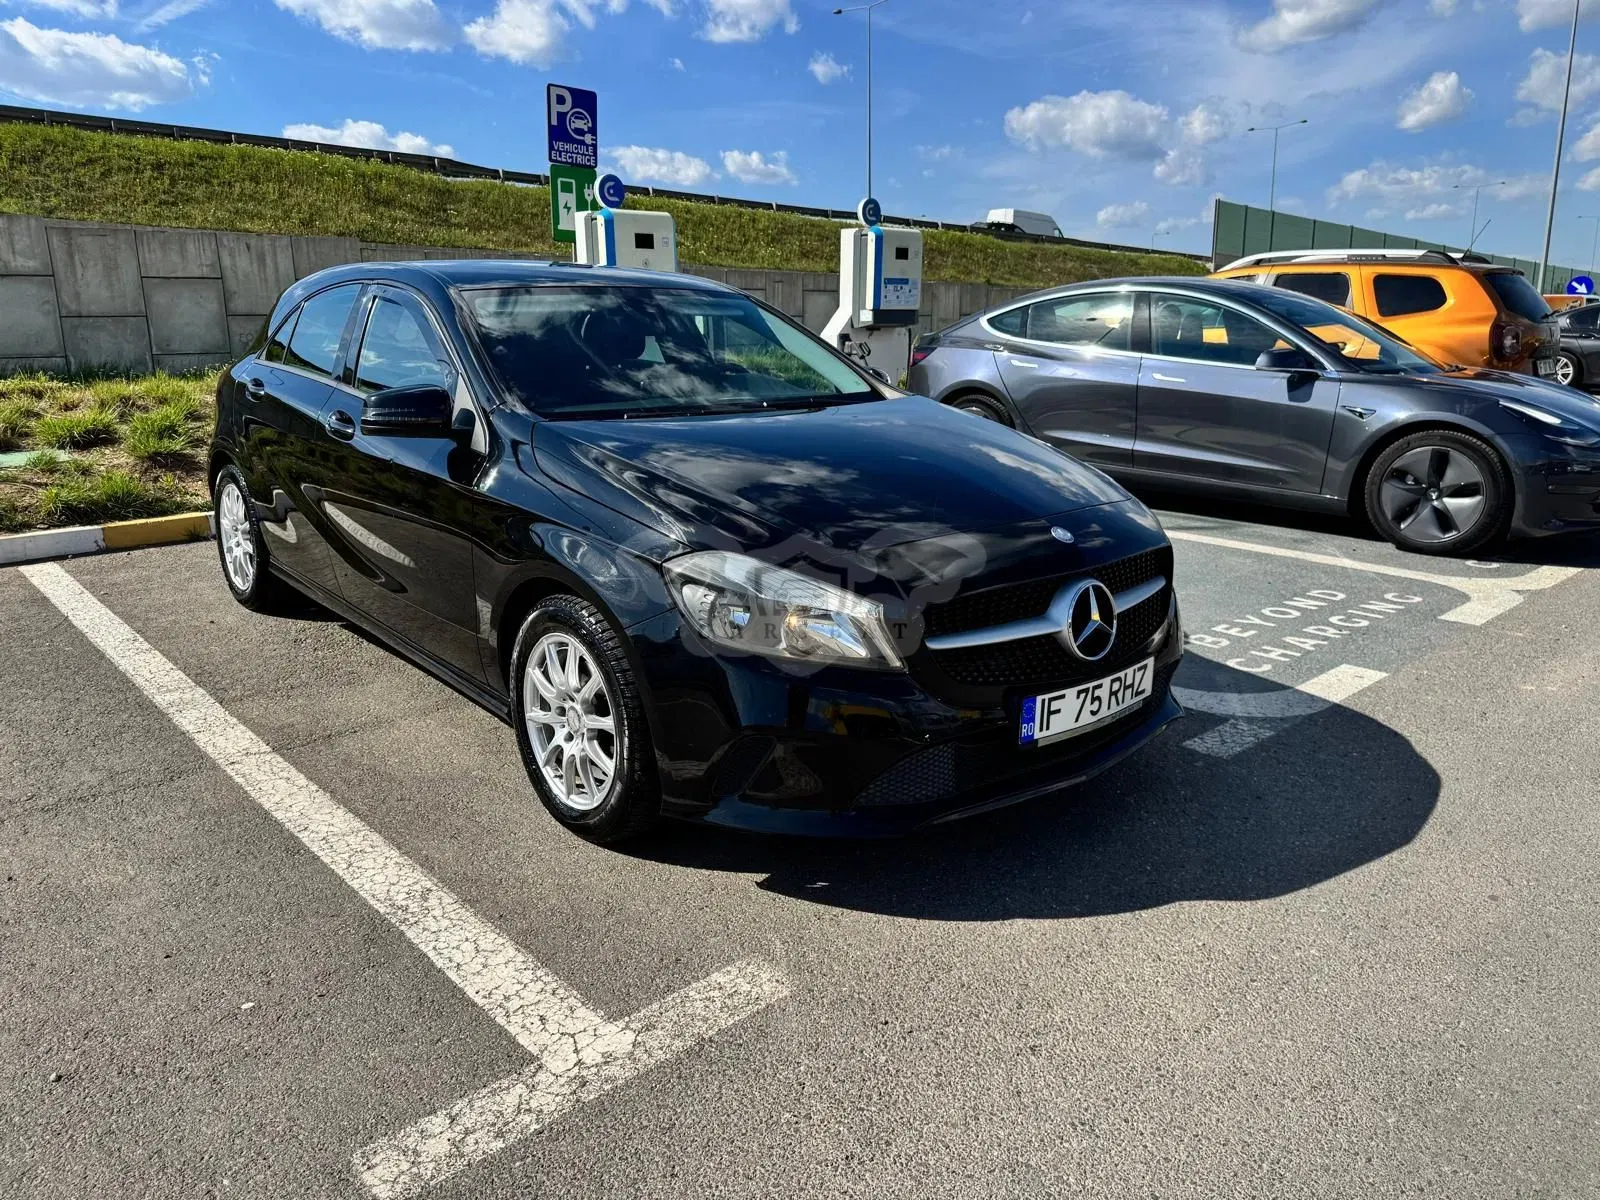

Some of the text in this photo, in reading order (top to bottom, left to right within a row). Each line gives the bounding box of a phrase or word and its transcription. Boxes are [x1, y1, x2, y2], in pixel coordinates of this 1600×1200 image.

[551, 86, 572, 126] P
[551, 151, 596, 166] ELECTRICE
[553, 141, 594, 155] VEHICULE
[1188, 589, 1347, 649] BEYOND
[1225, 592, 1423, 673] CHARGING
[1039, 694, 1066, 733] IF
[1074, 683, 1103, 723] 75
[1107, 663, 1148, 710] RHZ
[1022, 723, 1034, 738] RO
